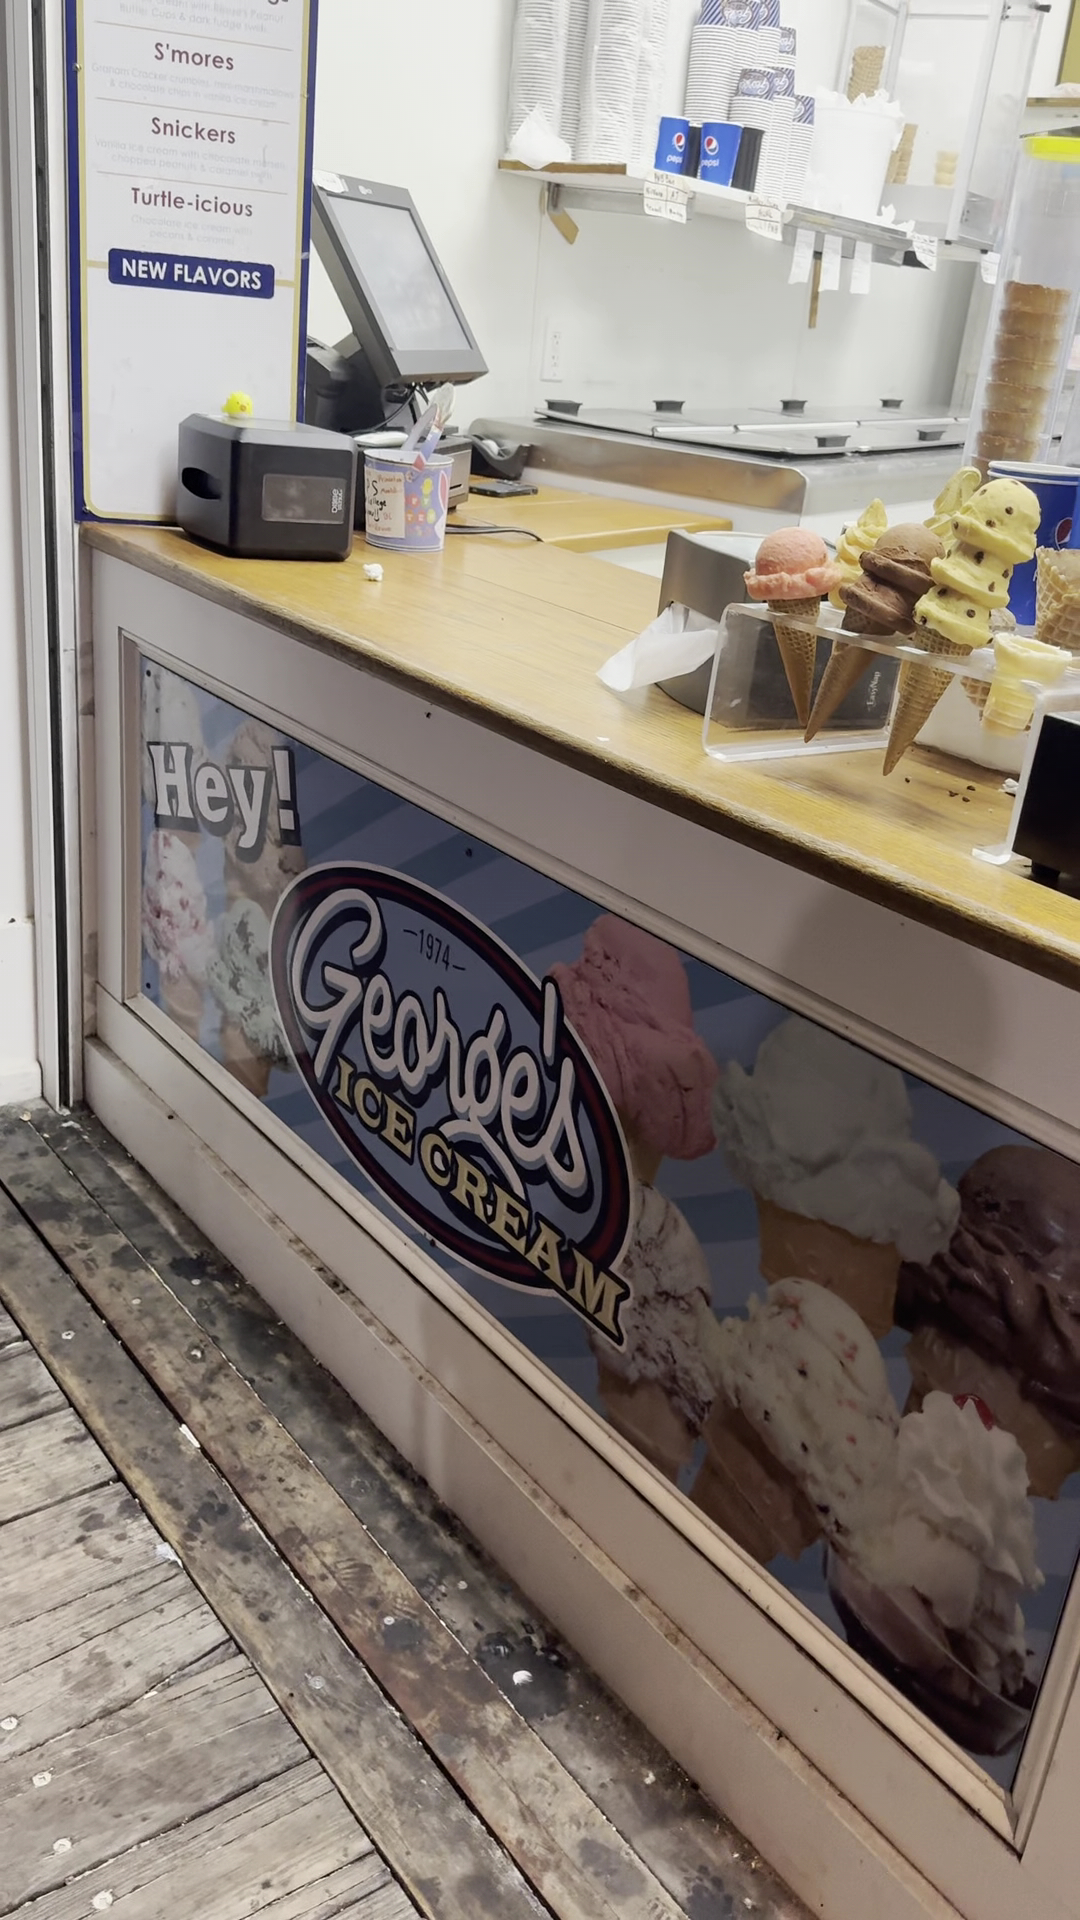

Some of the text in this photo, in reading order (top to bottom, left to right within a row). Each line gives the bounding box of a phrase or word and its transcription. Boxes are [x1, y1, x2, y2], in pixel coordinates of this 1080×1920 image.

[189, 13, 210, 25] dark
[213, 16, 242, 31] fudge
[154, 42, 235, 71] S'mores
[91, 62, 130, 76] Graham
[131, 68, 168, 81] Cracker
[109, 78, 117, 88] &
[118, 79, 165, 95] chocolate
[168, 85, 191, 98] chips
[151, 116, 236, 145] Snickers
[111, 153, 156, 169] chopped
[159, 158, 198, 172] peanuts
[200, 163, 207, 173] &
[129, 141, 144, 153] ice
[146, 145, 178, 156] cream
[180, 148, 200, 159] with
[131, 187, 253, 217] Turtle-icious
[131, 213, 182, 229] Chocolate
[184, 219, 199, 230] ice
[201, 223, 231, 234] cream
[149, 229, 185, 241] pecans
[187, 232, 194, 241] &
[121, 257, 262, 291] NEW FLAVORS
[147, 741, 302, 857] Hey!
[416, 926, 452, 971] 1974
[291, 886, 592, 1206] George's
[332, 1055, 628, 1343] ICE CREAM
